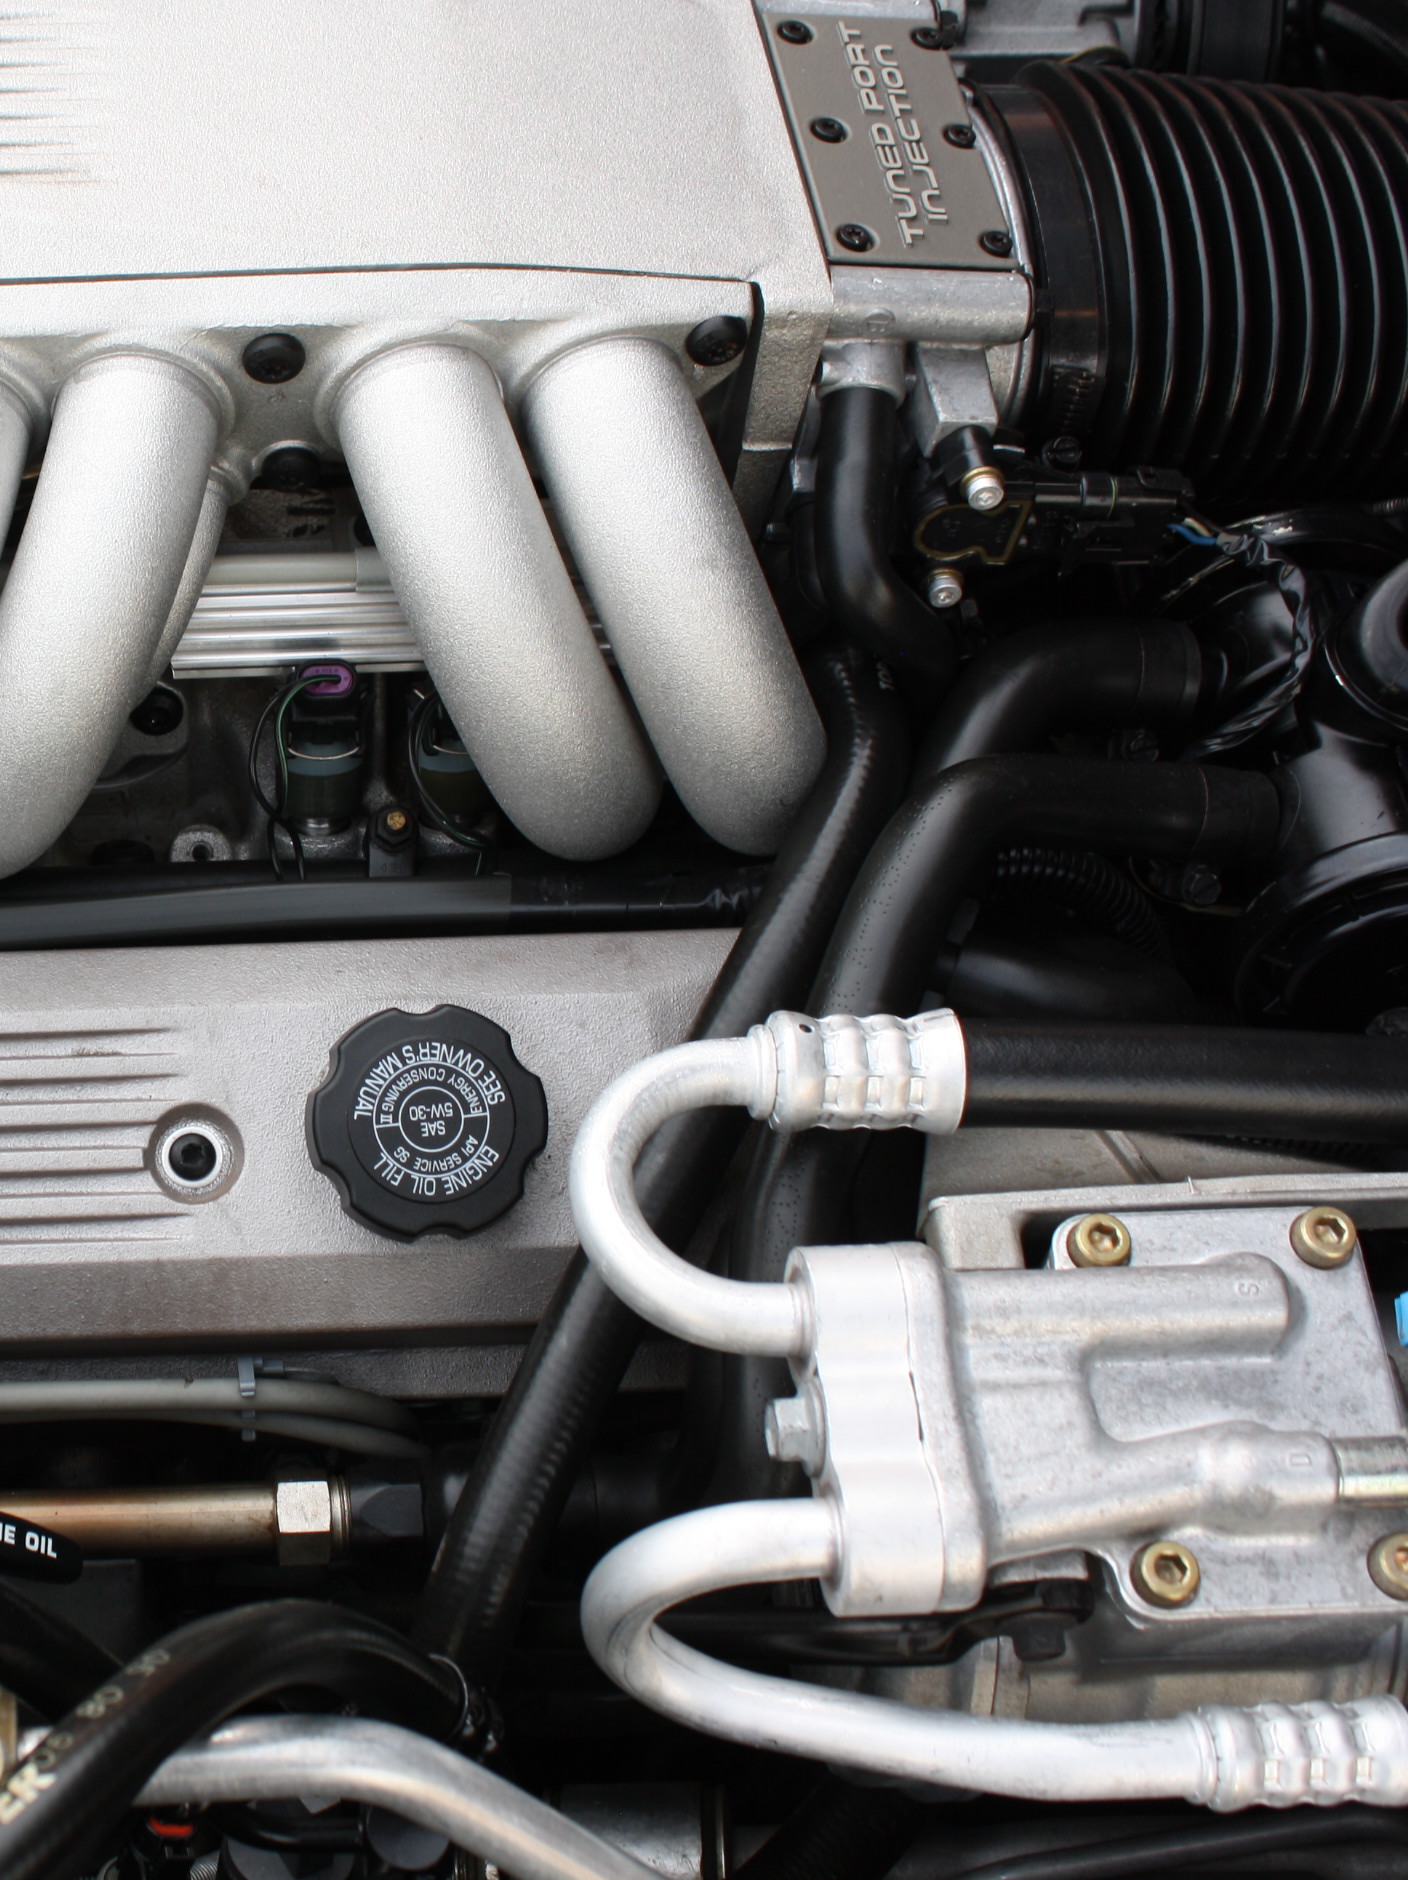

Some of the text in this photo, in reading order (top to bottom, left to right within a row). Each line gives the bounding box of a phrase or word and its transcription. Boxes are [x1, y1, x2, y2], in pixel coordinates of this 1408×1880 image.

[836, 21, 885, 113] PORT
[353, 1041, 506, 1120] SEE OWNER'S MANUAL
[381, 1066, 446, 1112] CONSERVING
[447, 1073, 482, 1114] ENERGY
[408, 1102, 453, 1121] 5W-30
[420, 1120, 446, 1137] SAE
[373, 1144, 499, 1196] ENGINE OIL FILL
[393, 1134, 479, 1173] API SERVICE SG
[24, 1530, 58, 1559] OIL
